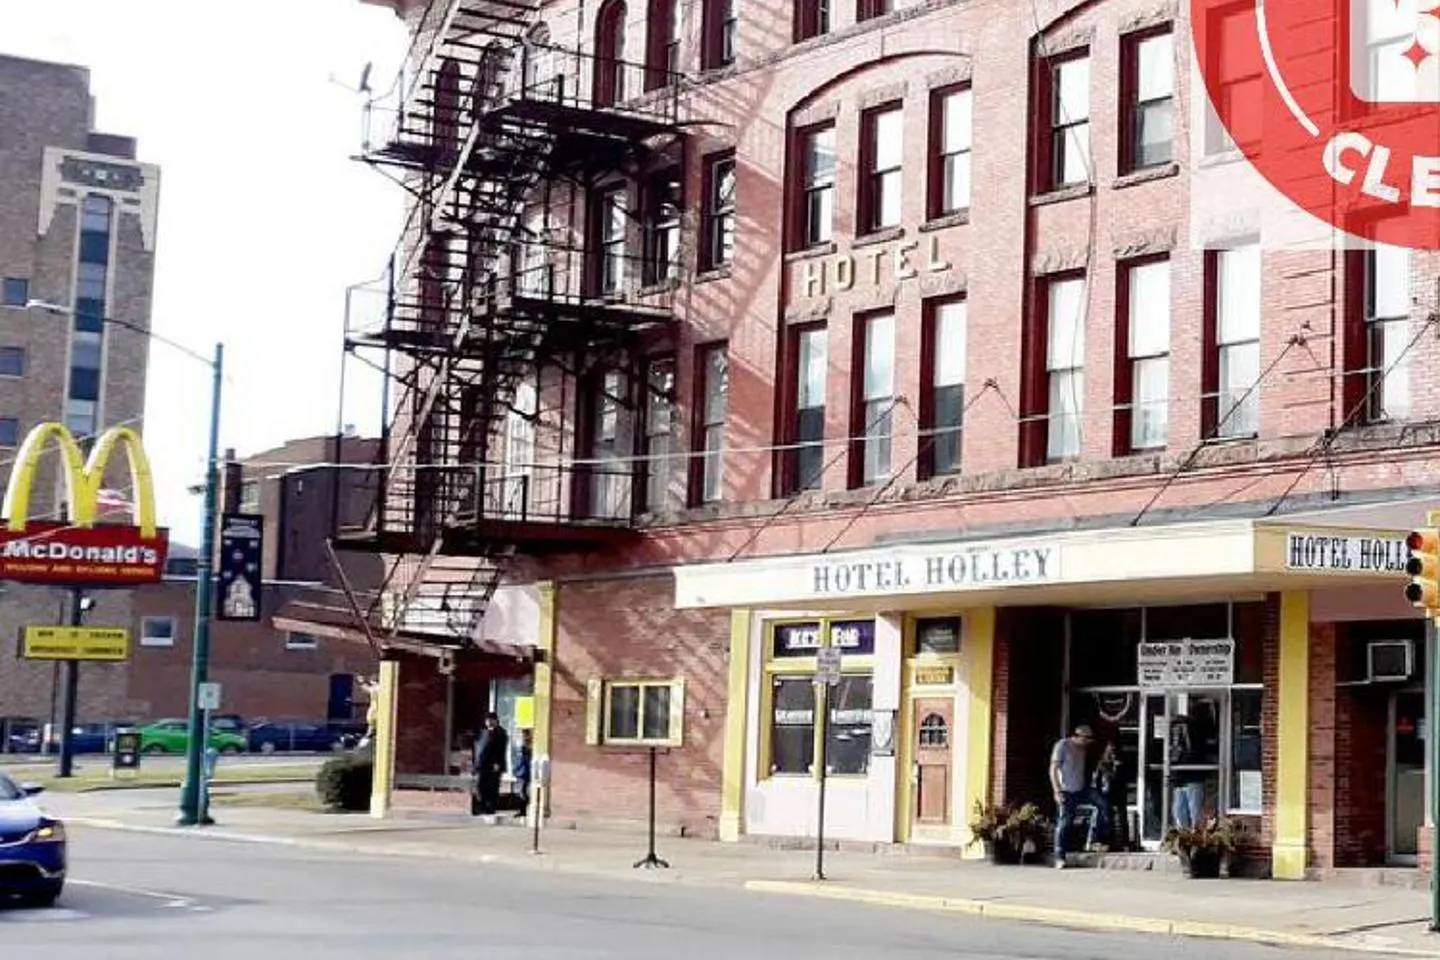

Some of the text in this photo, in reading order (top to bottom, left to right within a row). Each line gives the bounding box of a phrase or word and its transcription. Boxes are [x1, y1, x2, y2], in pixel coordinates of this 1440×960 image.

[802, 235, 953, 298] HOTEL
[2, 540, 157, 564] McDonald's
[813, 546, 1052, 593] HOTEL HOLLEY
[1290, 535, 1411, 571] HOTEL HOLL
